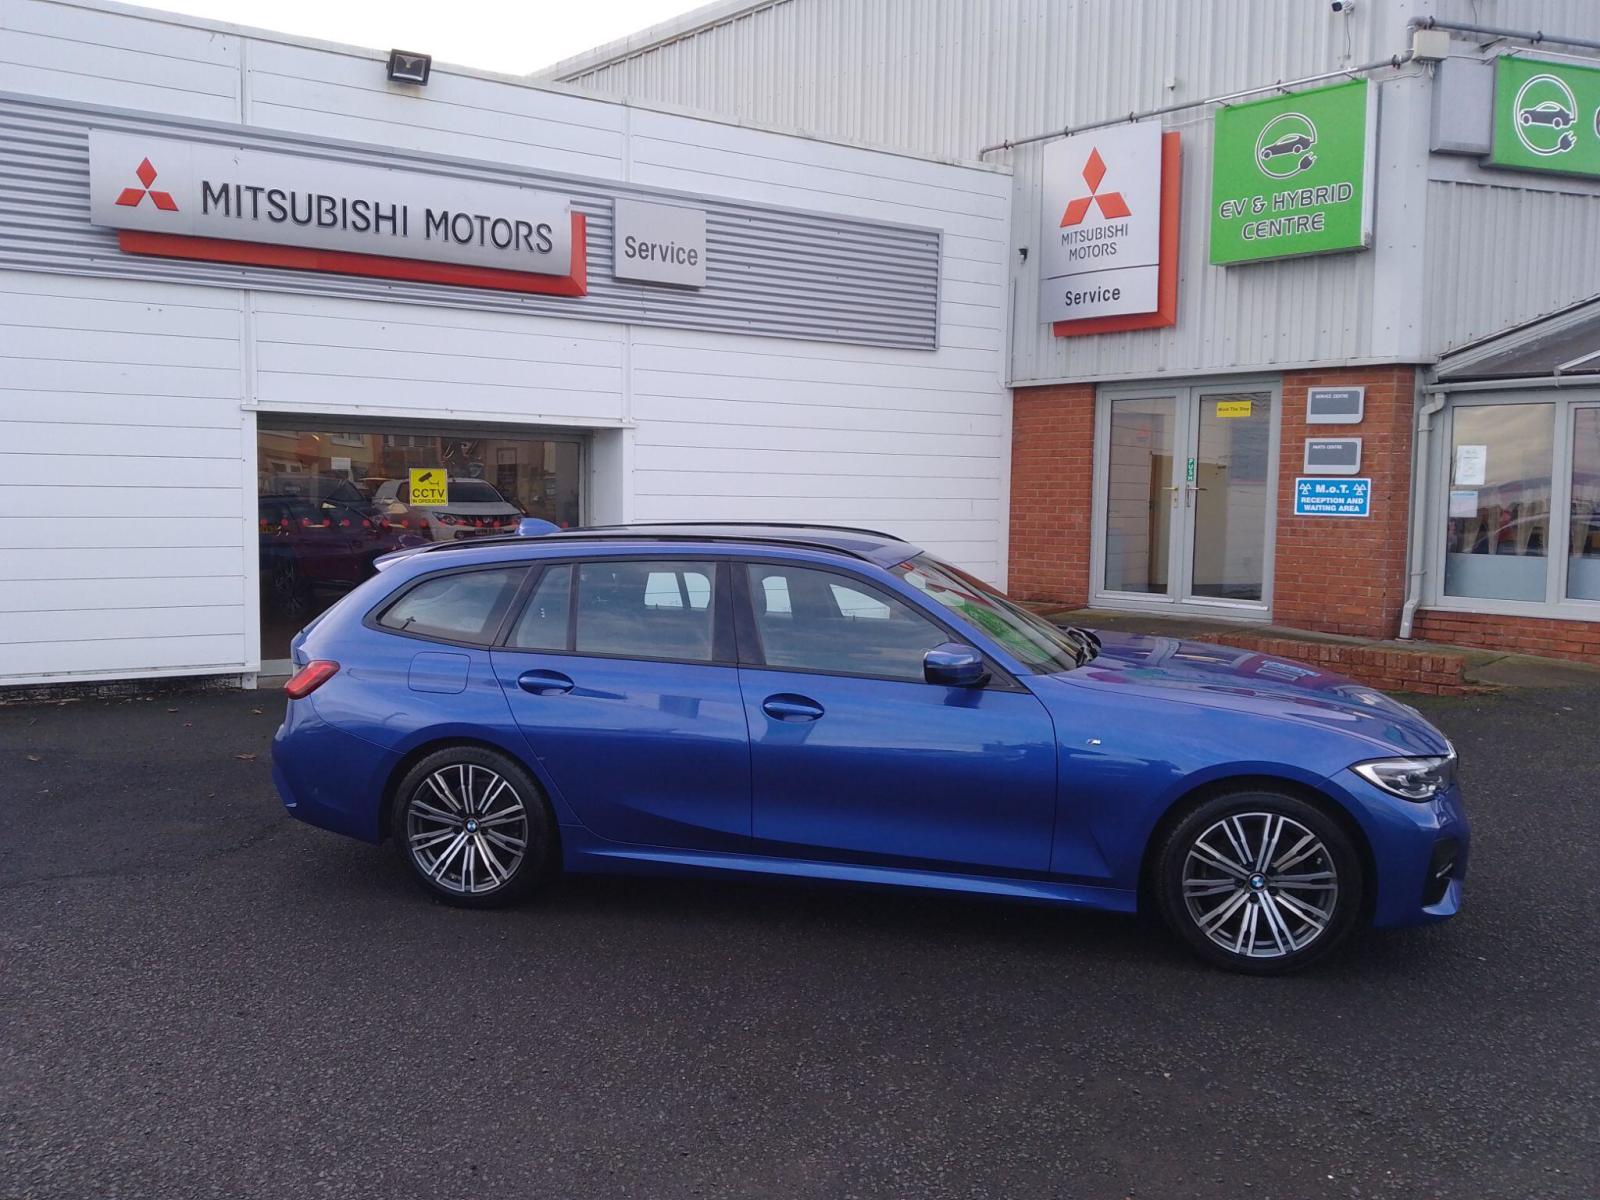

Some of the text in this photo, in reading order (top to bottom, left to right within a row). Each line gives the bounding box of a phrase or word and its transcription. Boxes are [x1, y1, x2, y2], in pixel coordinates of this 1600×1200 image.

[1219, 182, 1353, 219] EV & HYBRID
[201, 180, 553, 254] MITSUBISHI MOTORS
[1242, 212, 1325, 241] CENTRE
[1061, 223, 1128, 247] MITSUBISHI
[625, 235, 698, 266] Service
[1069, 242, 1117, 261] MOTORS
[1065, 285, 1121, 307] Service
[412, 488, 444, 498] CCTV
[1315, 484, 1350, 494] M.o.T.
[1301, 496, 1364, 505] RECEPTION AND
[1304, 504, 1337, 512] WAITING
